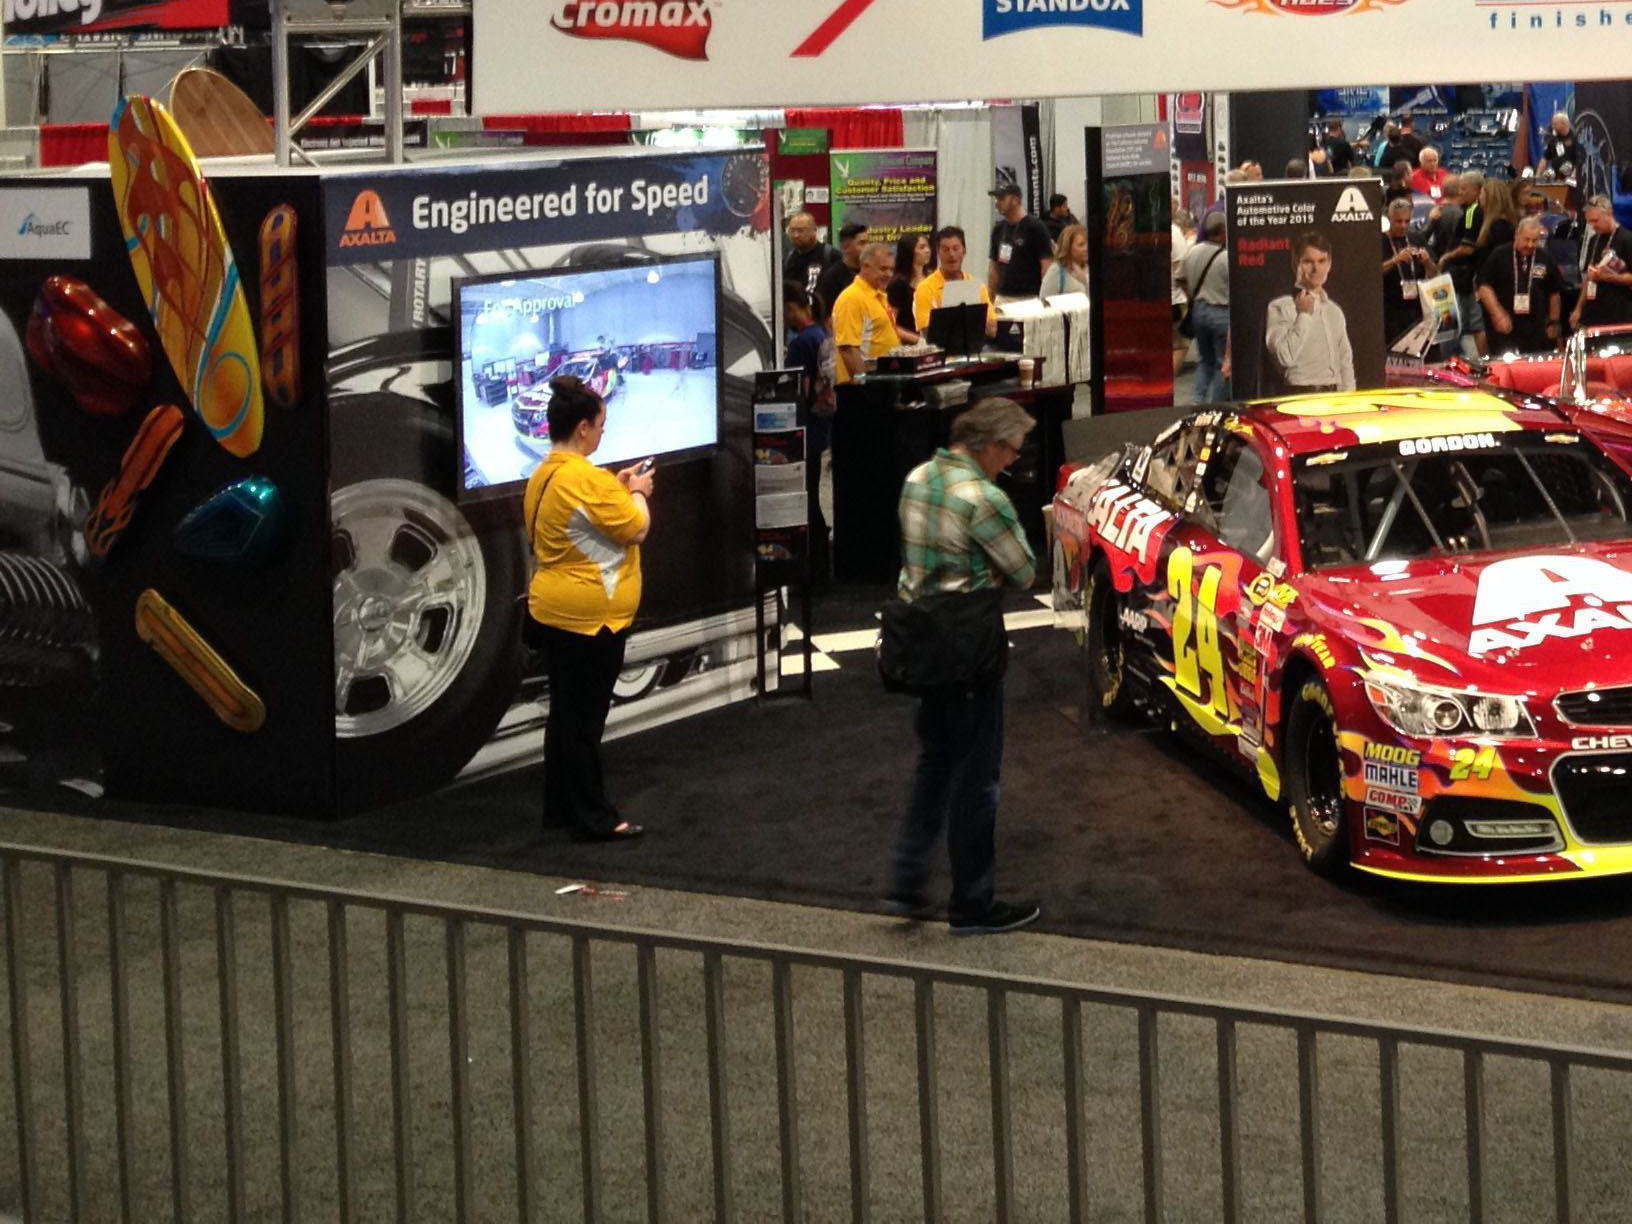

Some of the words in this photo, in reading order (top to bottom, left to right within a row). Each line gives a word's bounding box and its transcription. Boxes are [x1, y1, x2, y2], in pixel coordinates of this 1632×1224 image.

[412, 186, 577, 234] Engineered
[585, 183, 620, 214] for
[631, 176, 708, 213] Speed
[1237, 194, 1273, 205] Axalta's
[1237, 205, 1290, 216] Automotive
[1292, 203, 1315, 213] Color
[1331, 212, 1374, 222] AXALTA
[26, 221, 71, 237] AquaEC
[1237, 217, 1247, 227] of
[1249, 216, 1265, 226] the
[1267, 216, 1288, 225] Year
[1289, 215, 1314, 225] 2015
[339, 232, 397, 248] AXALTA
[1237, 238, 1290, 251] Radiant
[1238, 253, 1265, 267] Red
[412, 259, 430, 322] ROTARY
[1399, 432, 1496, 456] GORDON
[1167, 546, 1230, 724] 24
[1365, 742, 1421, 765] MOOG
[1450, 748, 1496, 780] 24
[1365, 764, 1418, 788] MAHLE
[1370, 790, 1407, 807] COMP
